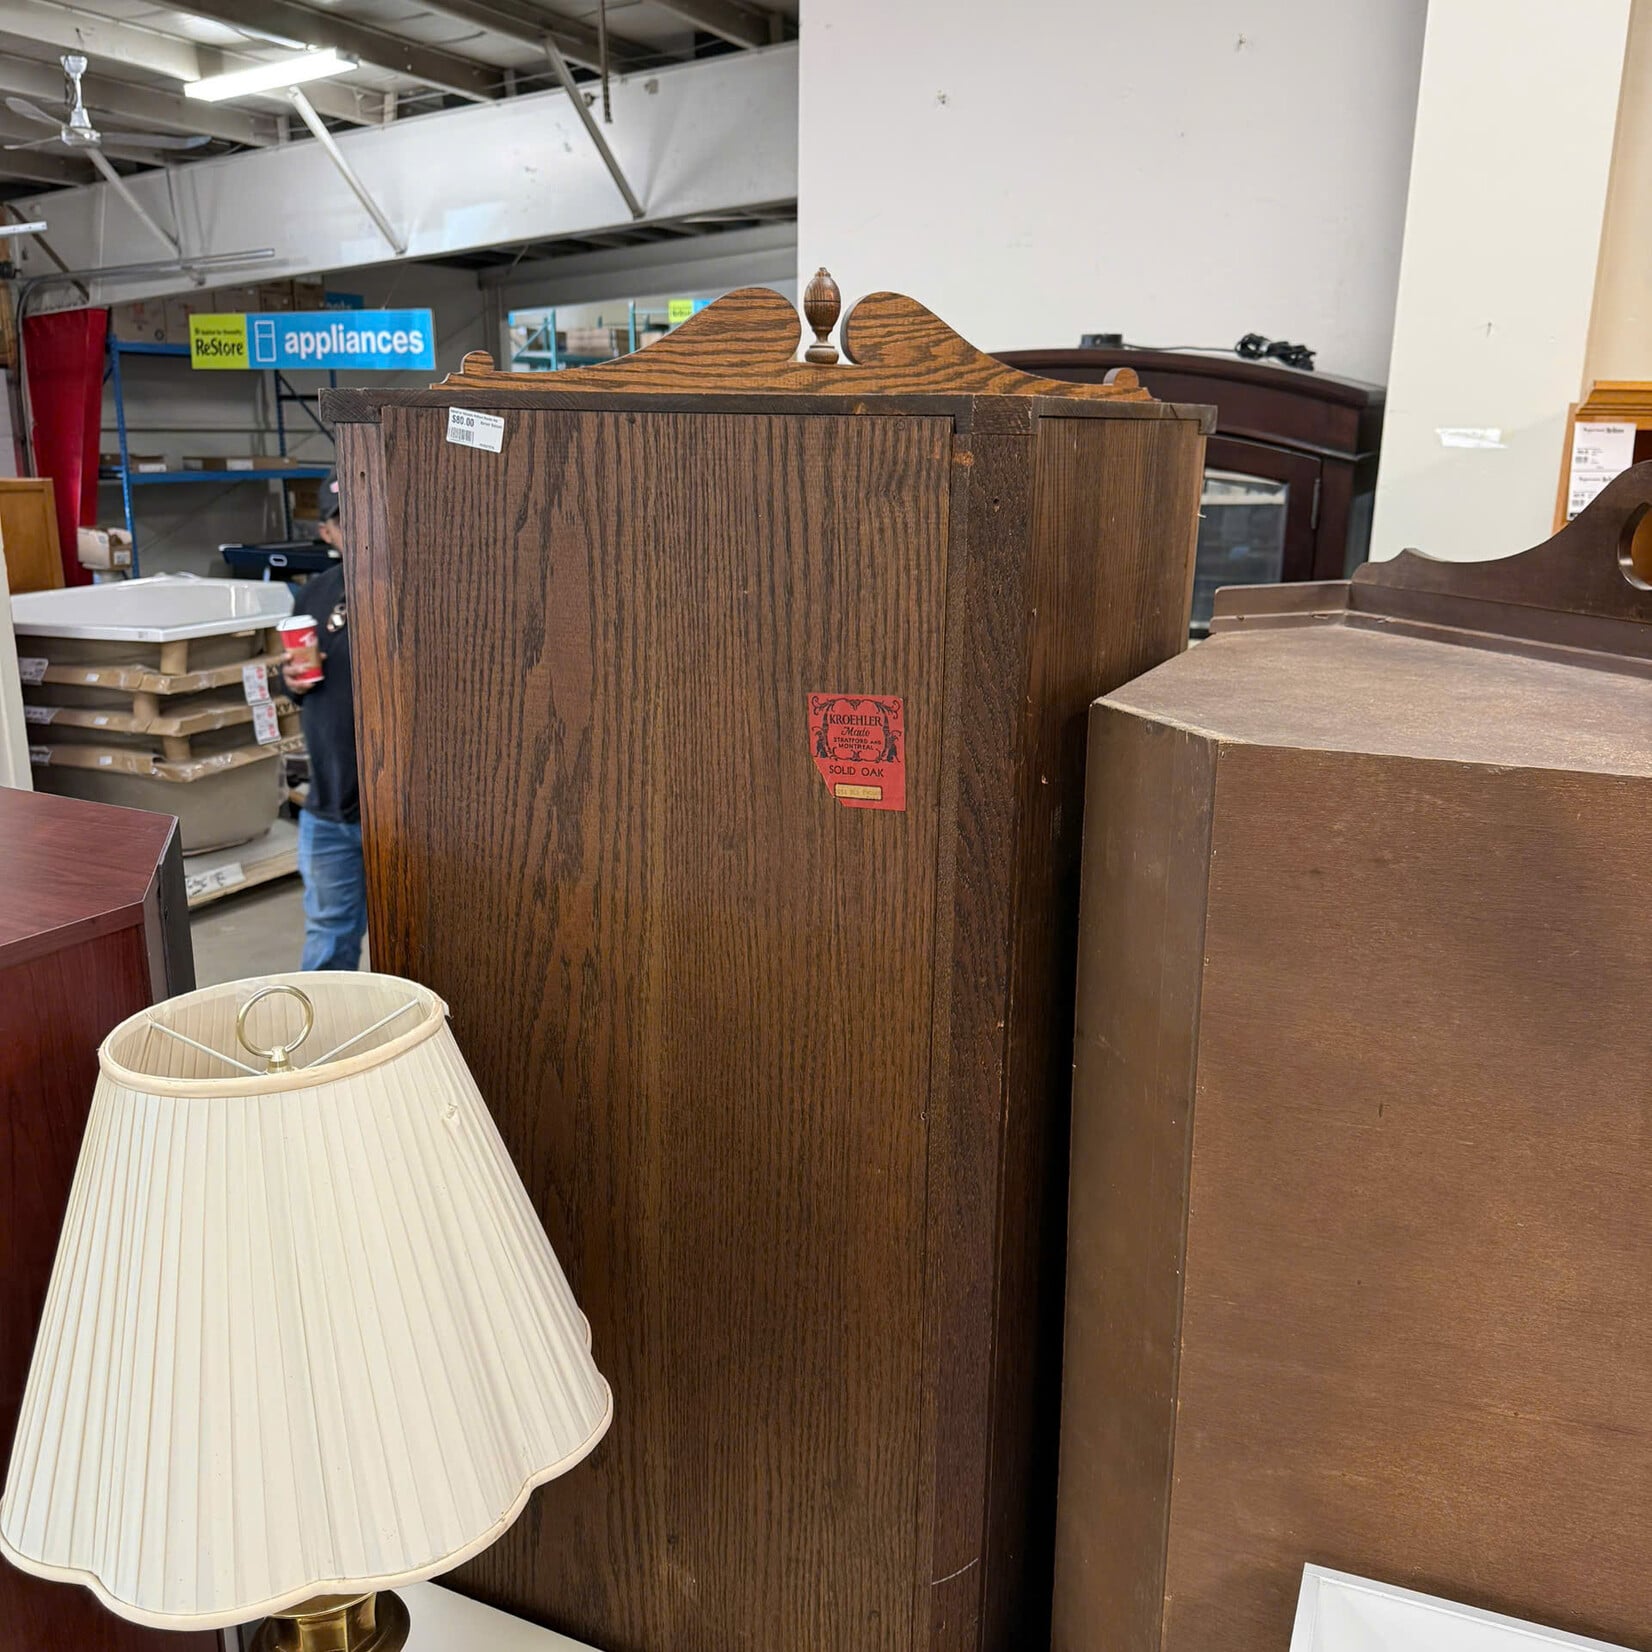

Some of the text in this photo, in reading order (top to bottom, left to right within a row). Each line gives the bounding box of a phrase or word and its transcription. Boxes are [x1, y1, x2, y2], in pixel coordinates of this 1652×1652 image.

[196, 338, 243, 356] ReStore
[285, 324, 424, 360] appliances
[452, 415, 474, 427] $80.00
[829, 714, 882, 726] KROEHLER
[833, 736, 868, 744] STRATFORD
[829, 765, 884, 778] SOLID OAK
